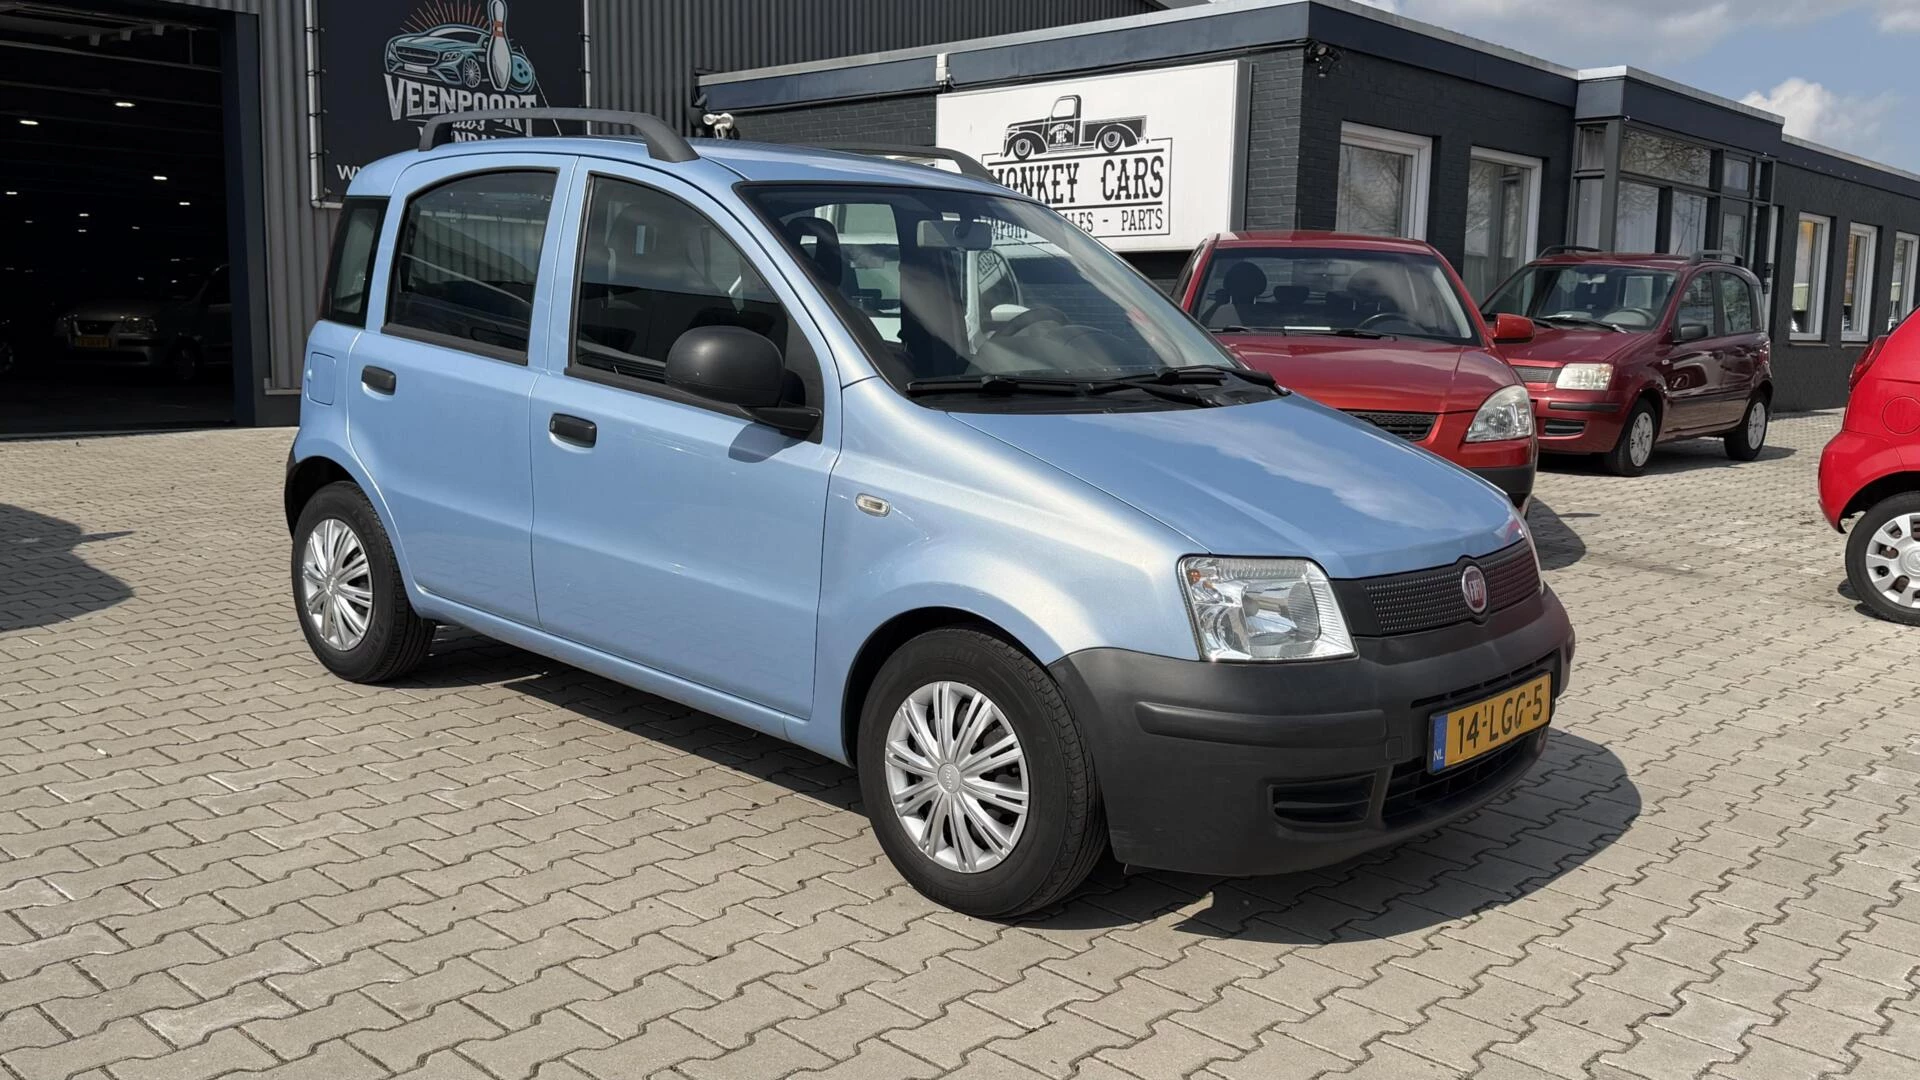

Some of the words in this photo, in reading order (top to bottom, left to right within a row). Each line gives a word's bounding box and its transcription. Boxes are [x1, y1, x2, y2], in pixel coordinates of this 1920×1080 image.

[1101, 156, 1164, 201] CARS
[1121, 208, 1163, 232] PARTS
[1433, 750, 1444, 761] NL
